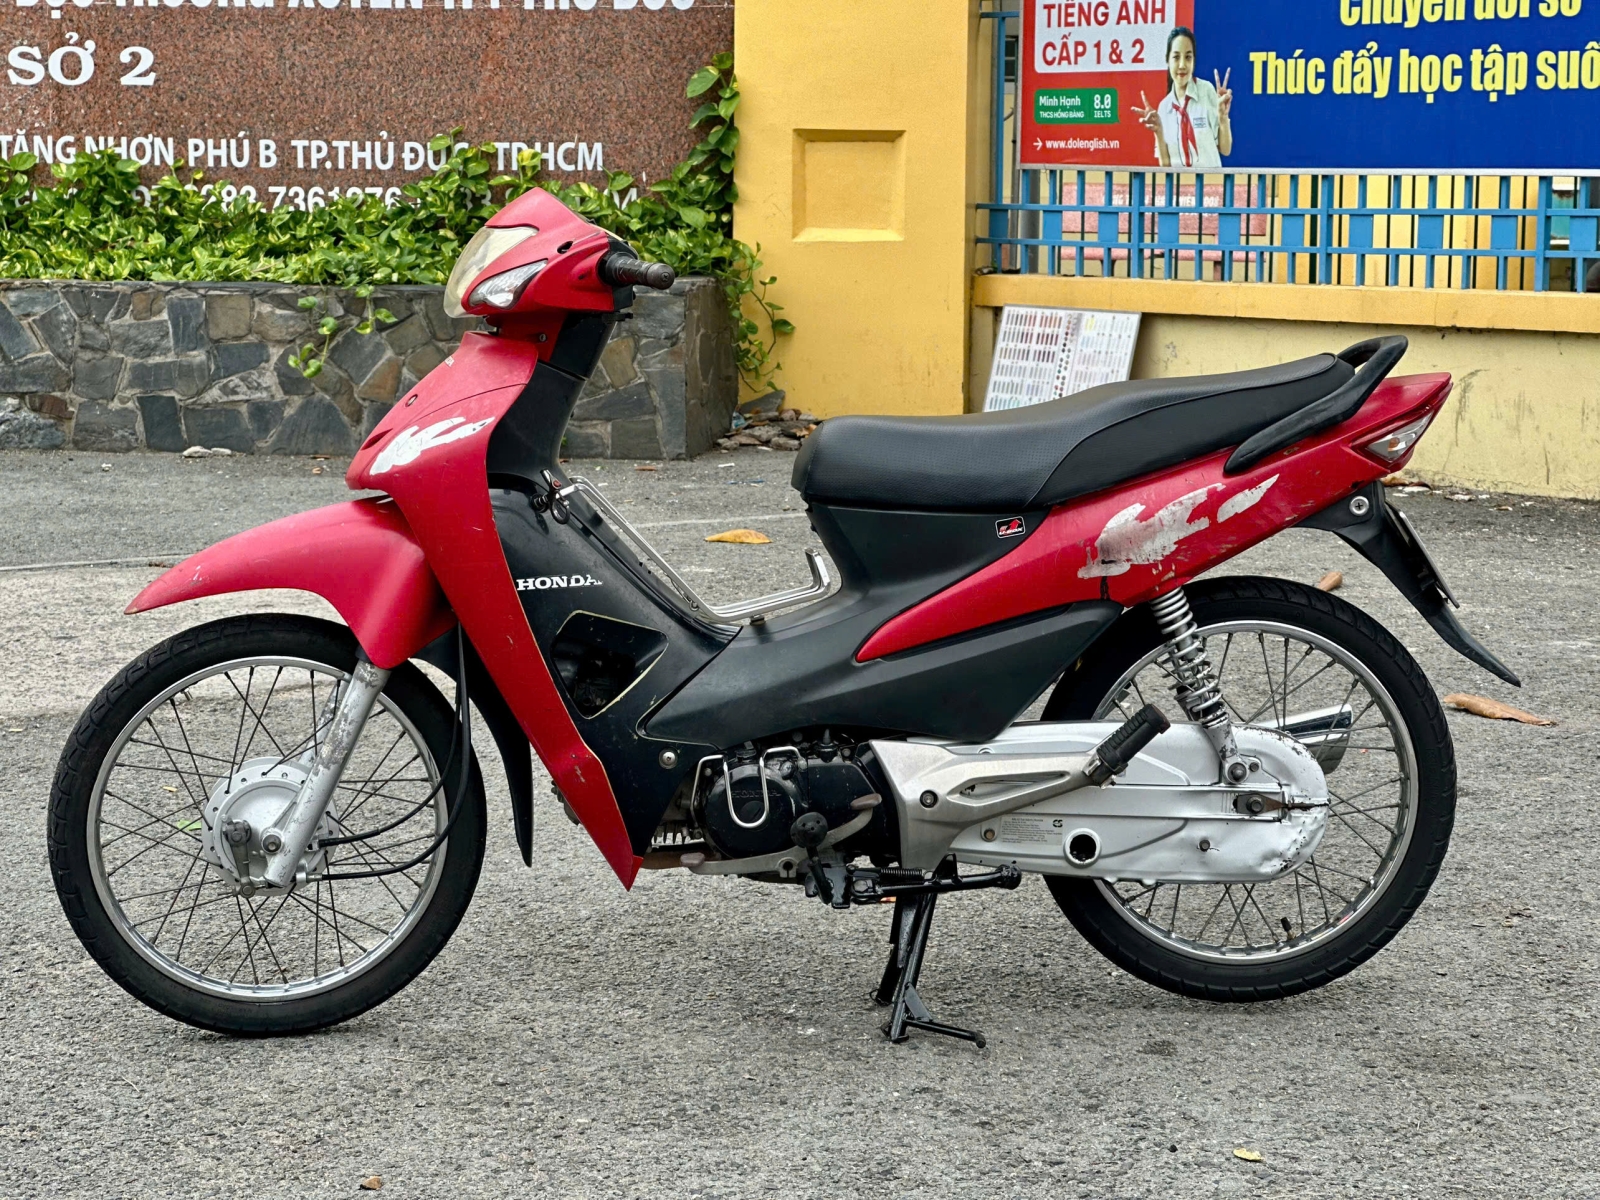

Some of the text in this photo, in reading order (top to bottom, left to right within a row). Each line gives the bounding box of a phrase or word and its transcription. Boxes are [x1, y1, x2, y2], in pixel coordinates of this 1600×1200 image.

[1042, 32, 1145, 66] CẤP 1 & 2
[7, 31, 156, 86] SỞ 2
[1249, 49, 1326, 94] Thúc
[1332, 41, 1392, 98] đẩy
[1398, 48, 1463, 104] học
[1470, 43, 1528, 102] tập
[1039, 95, 1081, 109] Minh Hạnh
[1094, 94, 1111, 109] 8.0
[1094, 110, 1111, 118] IELTS
[187, 130, 250, 168] PHÚ
[259, 138, 277, 168] B
[291, 130, 394, 170] TP.THỦ
[493, 141, 603, 171] TPHCM
[1045, 137, 1120, 151] www.dolenglish.vn
[516, 574, 603, 591] HONDA
